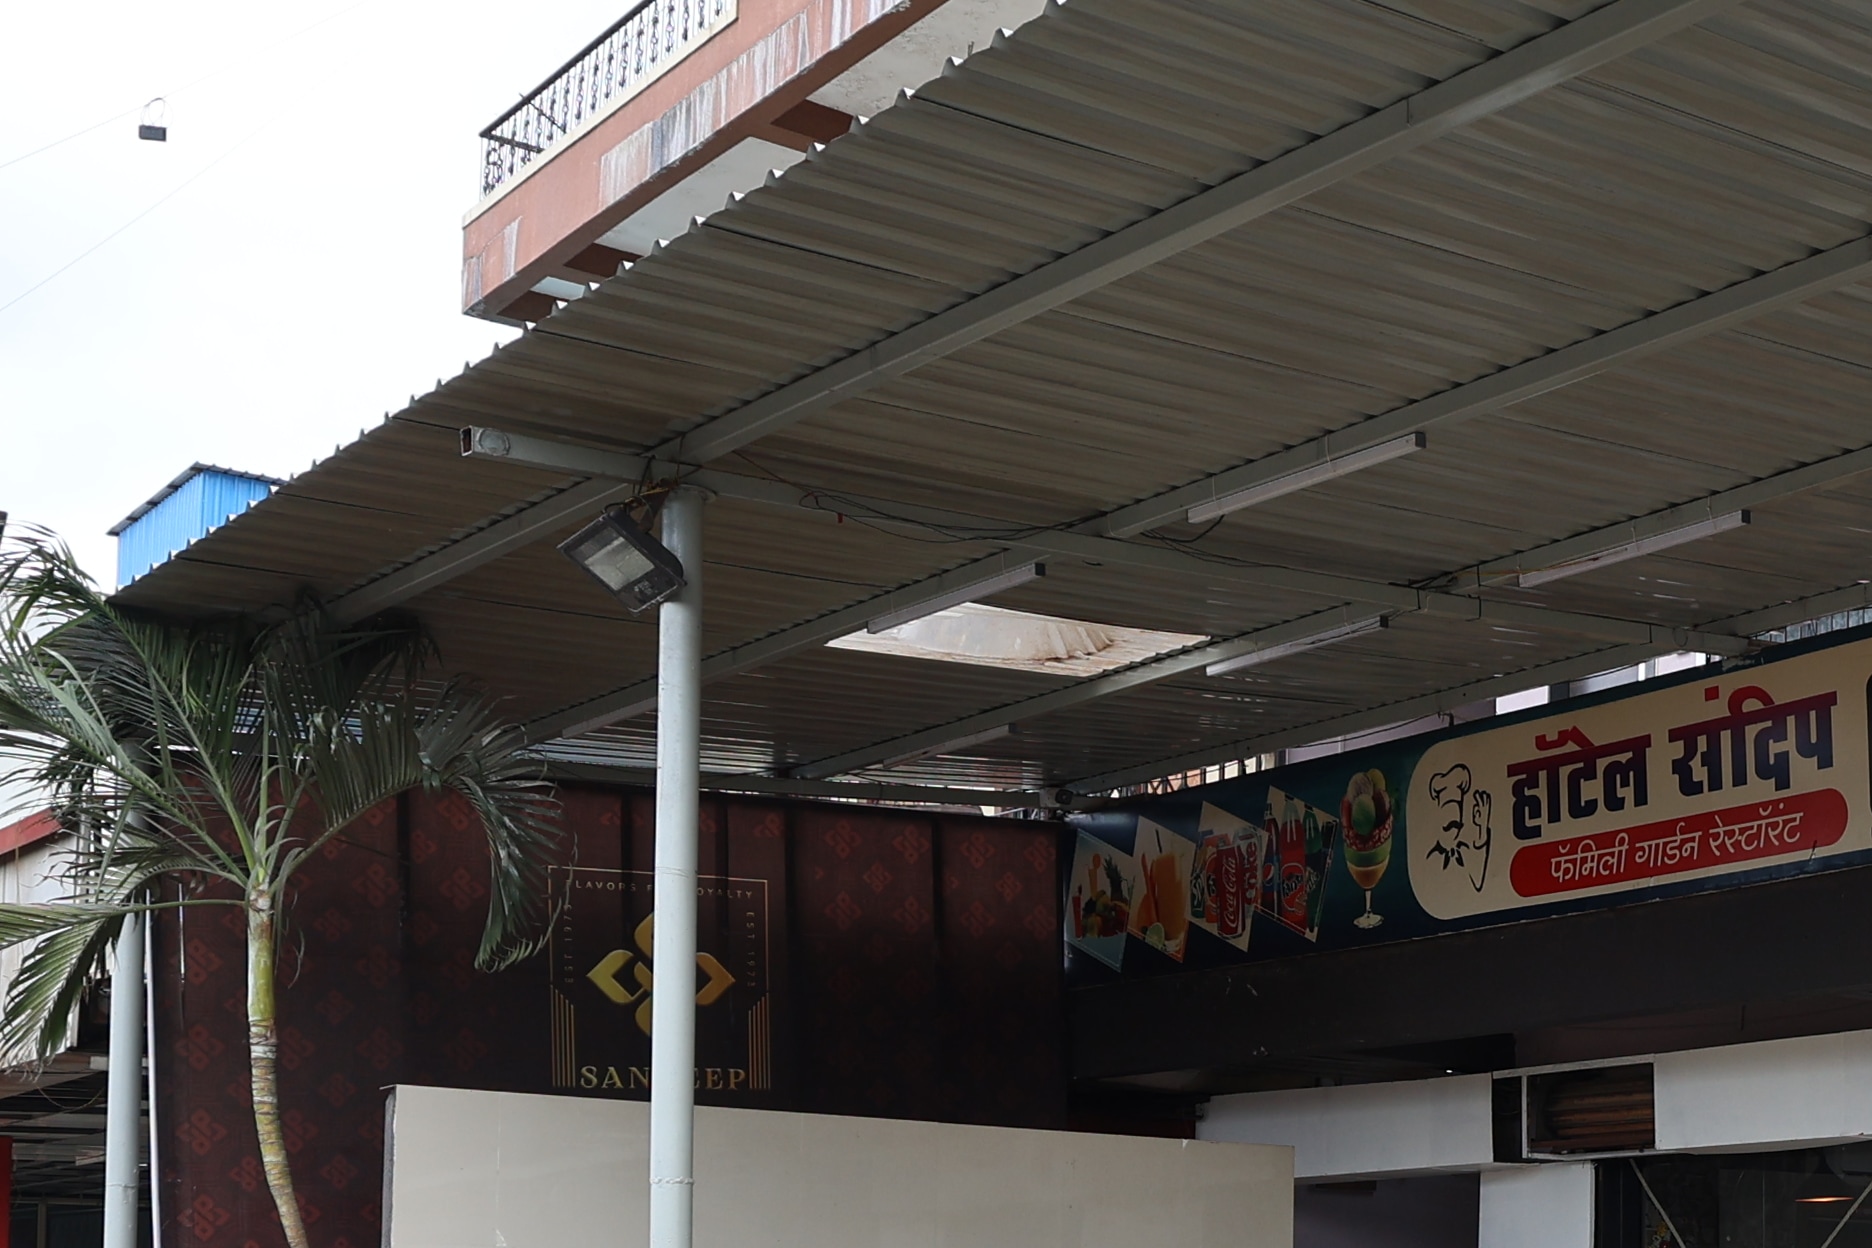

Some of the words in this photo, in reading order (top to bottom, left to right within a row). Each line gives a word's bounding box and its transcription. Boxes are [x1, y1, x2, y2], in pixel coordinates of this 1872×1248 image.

[1507, 725, 1652, 840] हॉटेल
[1668, 685, 1838, 798] संदिप
[1550, 832, 1629, 882] फॅमिली
[1635, 822, 1702, 868] गार्डन
[1708, 803, 1804, 856] रेस्टॉरंट
[566, 879, 636, 892] LAVORS
[697, 885, 753, 900] OYALTY
[580, 1065, 746, 1090] SANEP
